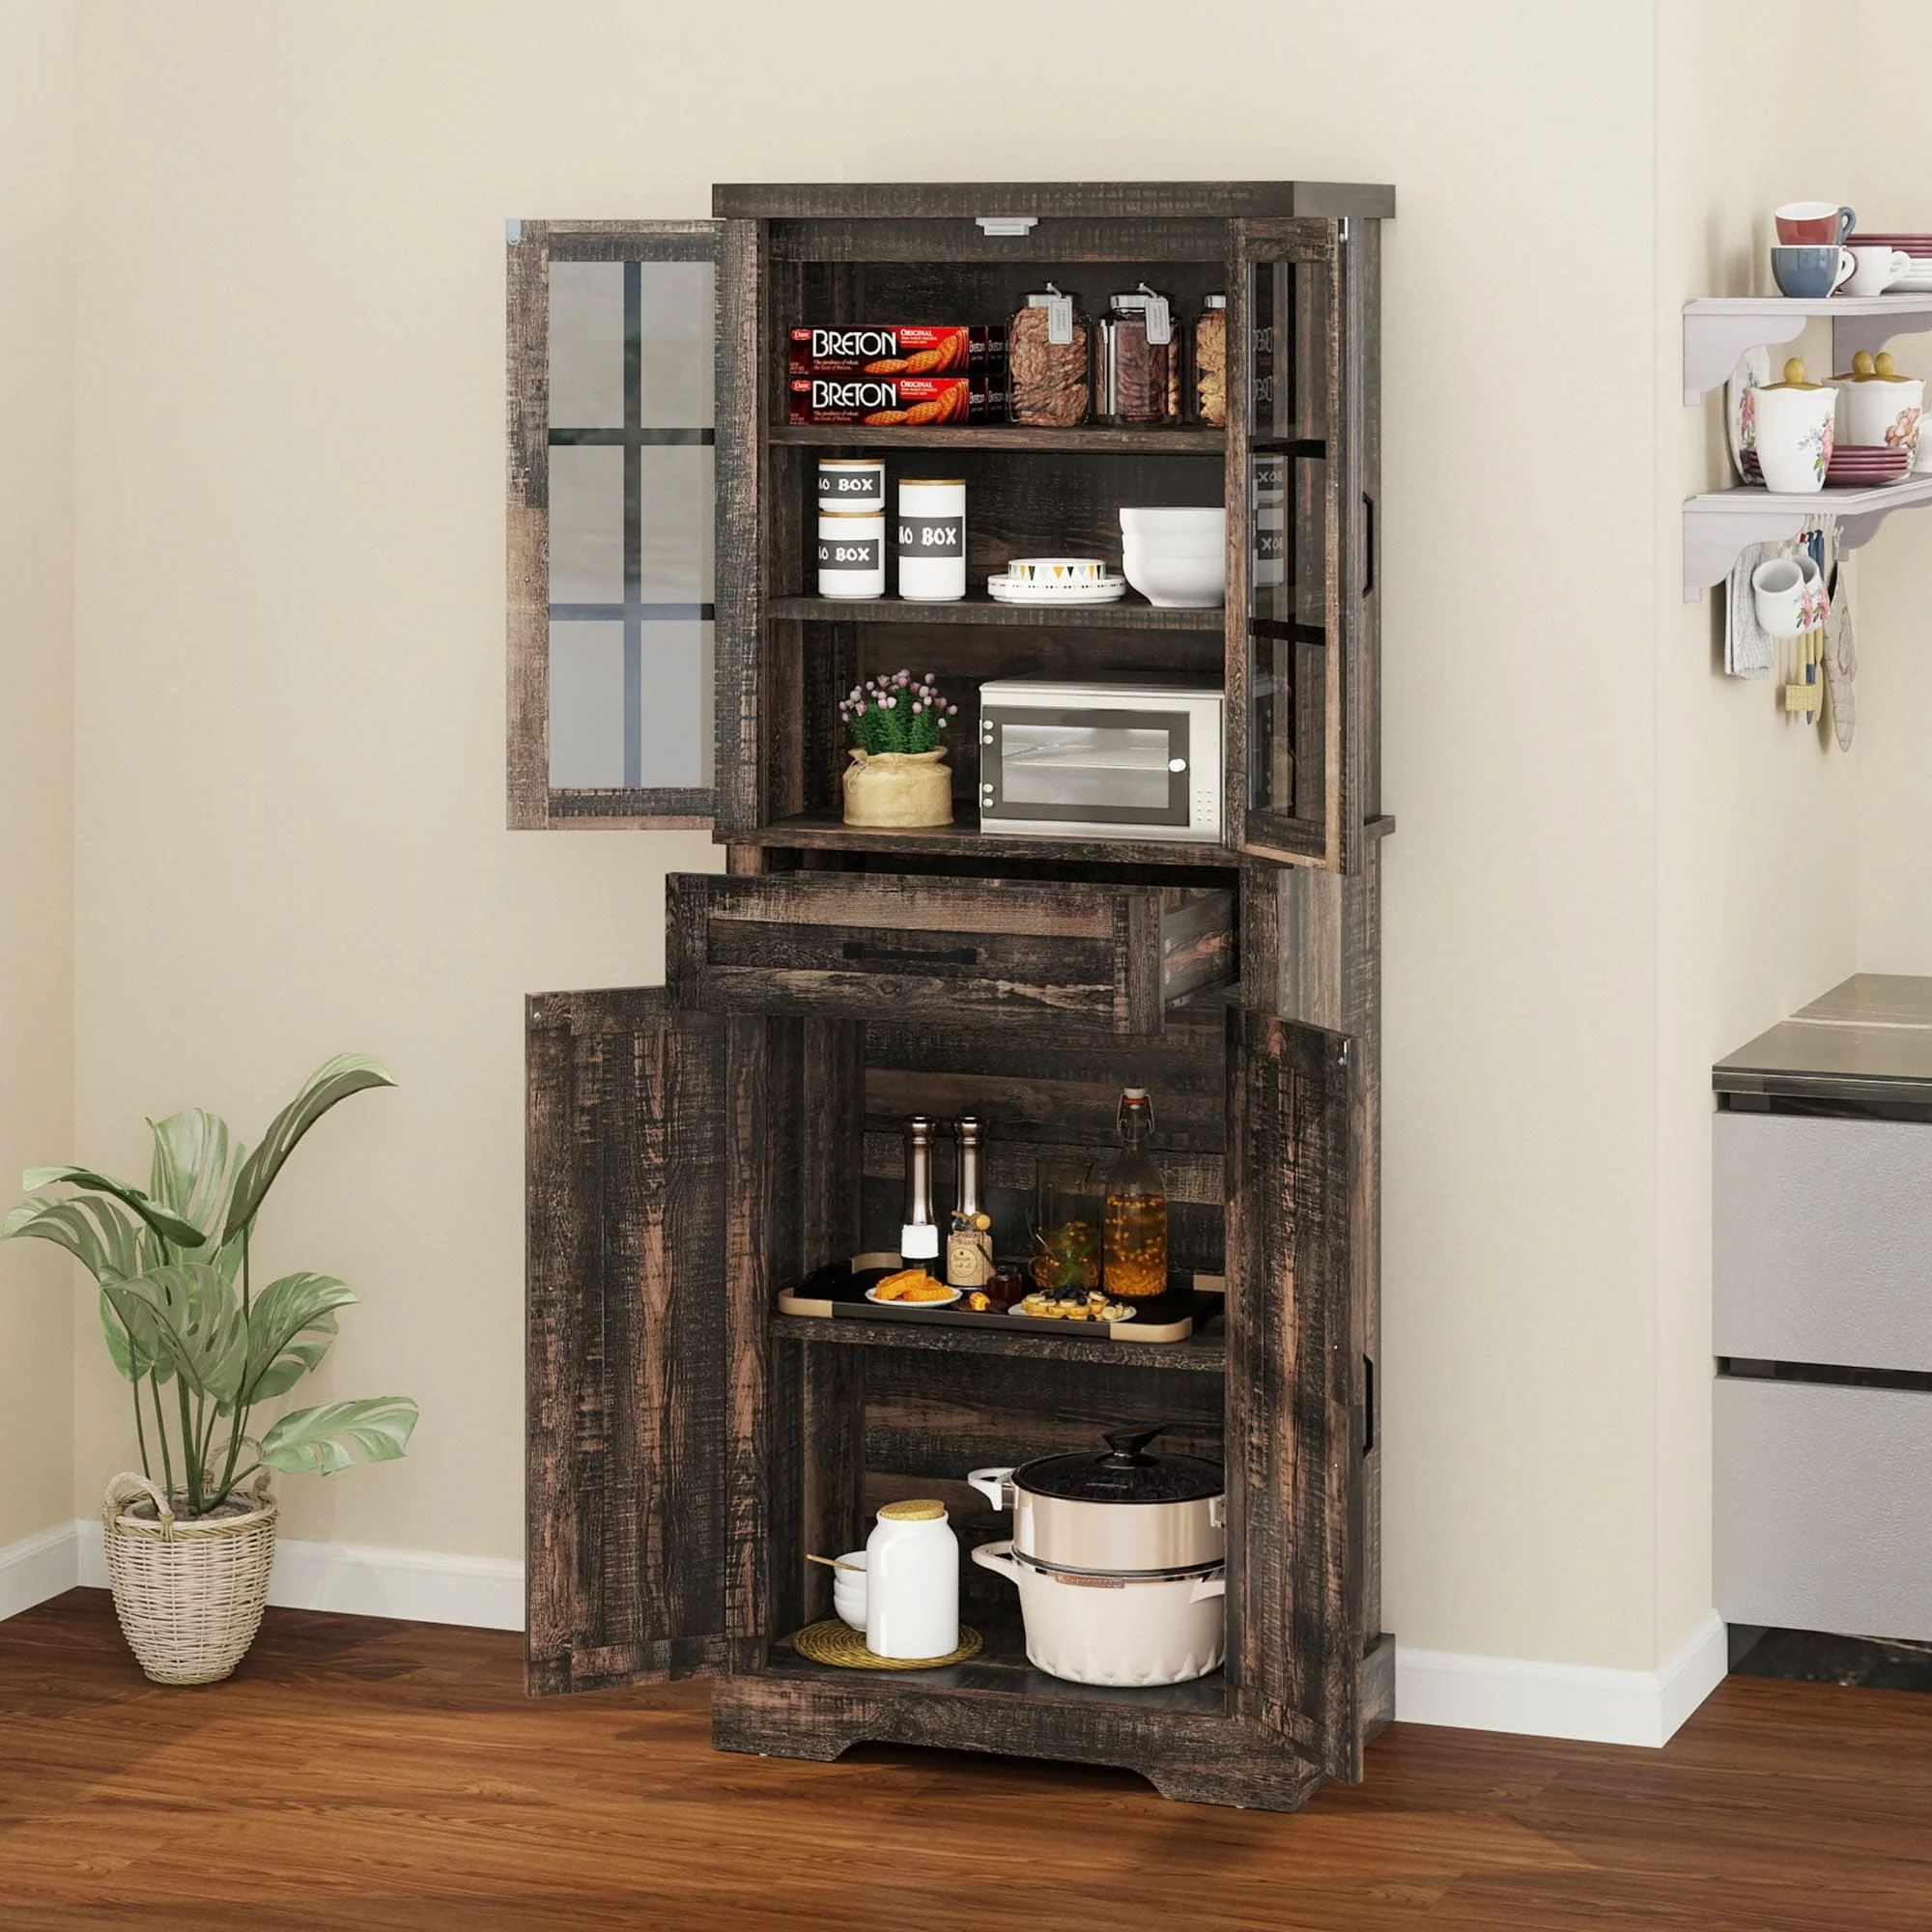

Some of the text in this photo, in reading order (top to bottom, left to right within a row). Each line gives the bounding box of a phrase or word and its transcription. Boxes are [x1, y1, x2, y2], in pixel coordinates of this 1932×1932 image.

[812, 329, 896, 357] BRETON
[812, 380, 896, 409] BRETON
[838, 478, 873, 492] BOX
[922, 526, 956, 547] BOX
[836, 547, 869, 562] BOX
